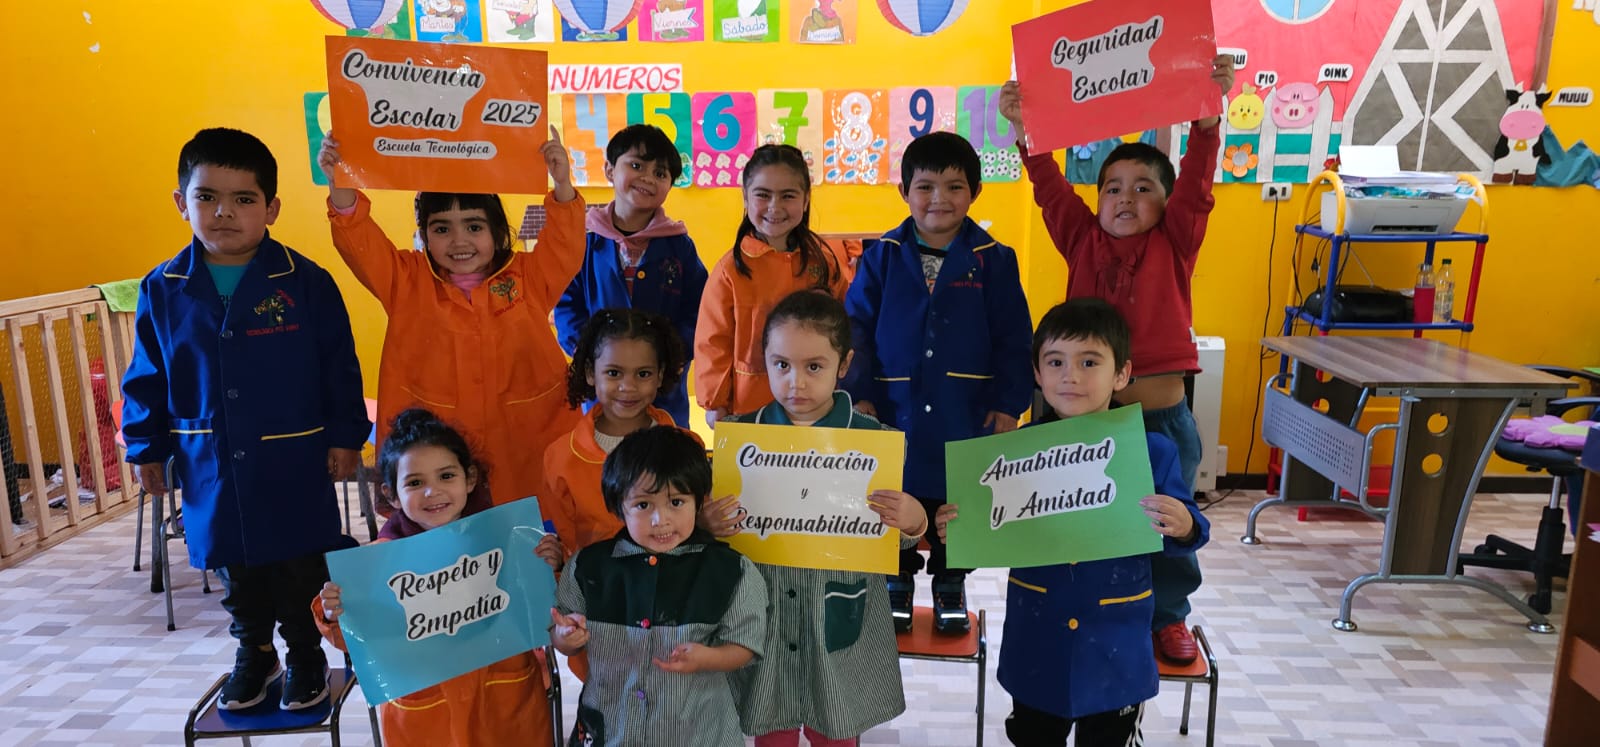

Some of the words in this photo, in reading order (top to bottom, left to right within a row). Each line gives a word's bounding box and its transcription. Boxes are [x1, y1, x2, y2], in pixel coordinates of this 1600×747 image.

[723, 18, 766, 36] Sábado
[1053, 20, 1159, 65] Seguridad
[343, 52, 483, 89] Convivencia
[550, 65, 680, 91] NUMEROS
[1073, 69, 1150, 100] Escolar
[1258, 73, 1275, 84] PIO
[1324, 67, 1348, 79] OINK
[370, 99, 460, 130] Escolar
[483, 101, 539, 124] 2025
[908, 88, 934, 138] 9
[1558, 92, 1588, 103] MUUU
[643, 93, 677, 144] 5
[702, 94, 741, 151] 6
[773, 92, 808, 147] 7
[840, 92, 873, 150] 8
[963, 88, 1017, 149] 10
[377, 139, 422, 152] Escuela
[426, 140, 489, 157] Tecnológica
[739, 445, 876, 472] Comunicación
[982, 440, 1113, 483] Amabilidad
[801, 487, 809, 499] y
[992, 504, 1007, 527] y
[1017, 483, 1113, 518] Amistad
[734, 506, 886, 537] Responsabilidad
[389, 557, 480, 600] Respeto
[488, 551, 500, 575] y
[408, 593, 505, 640] Empatía
